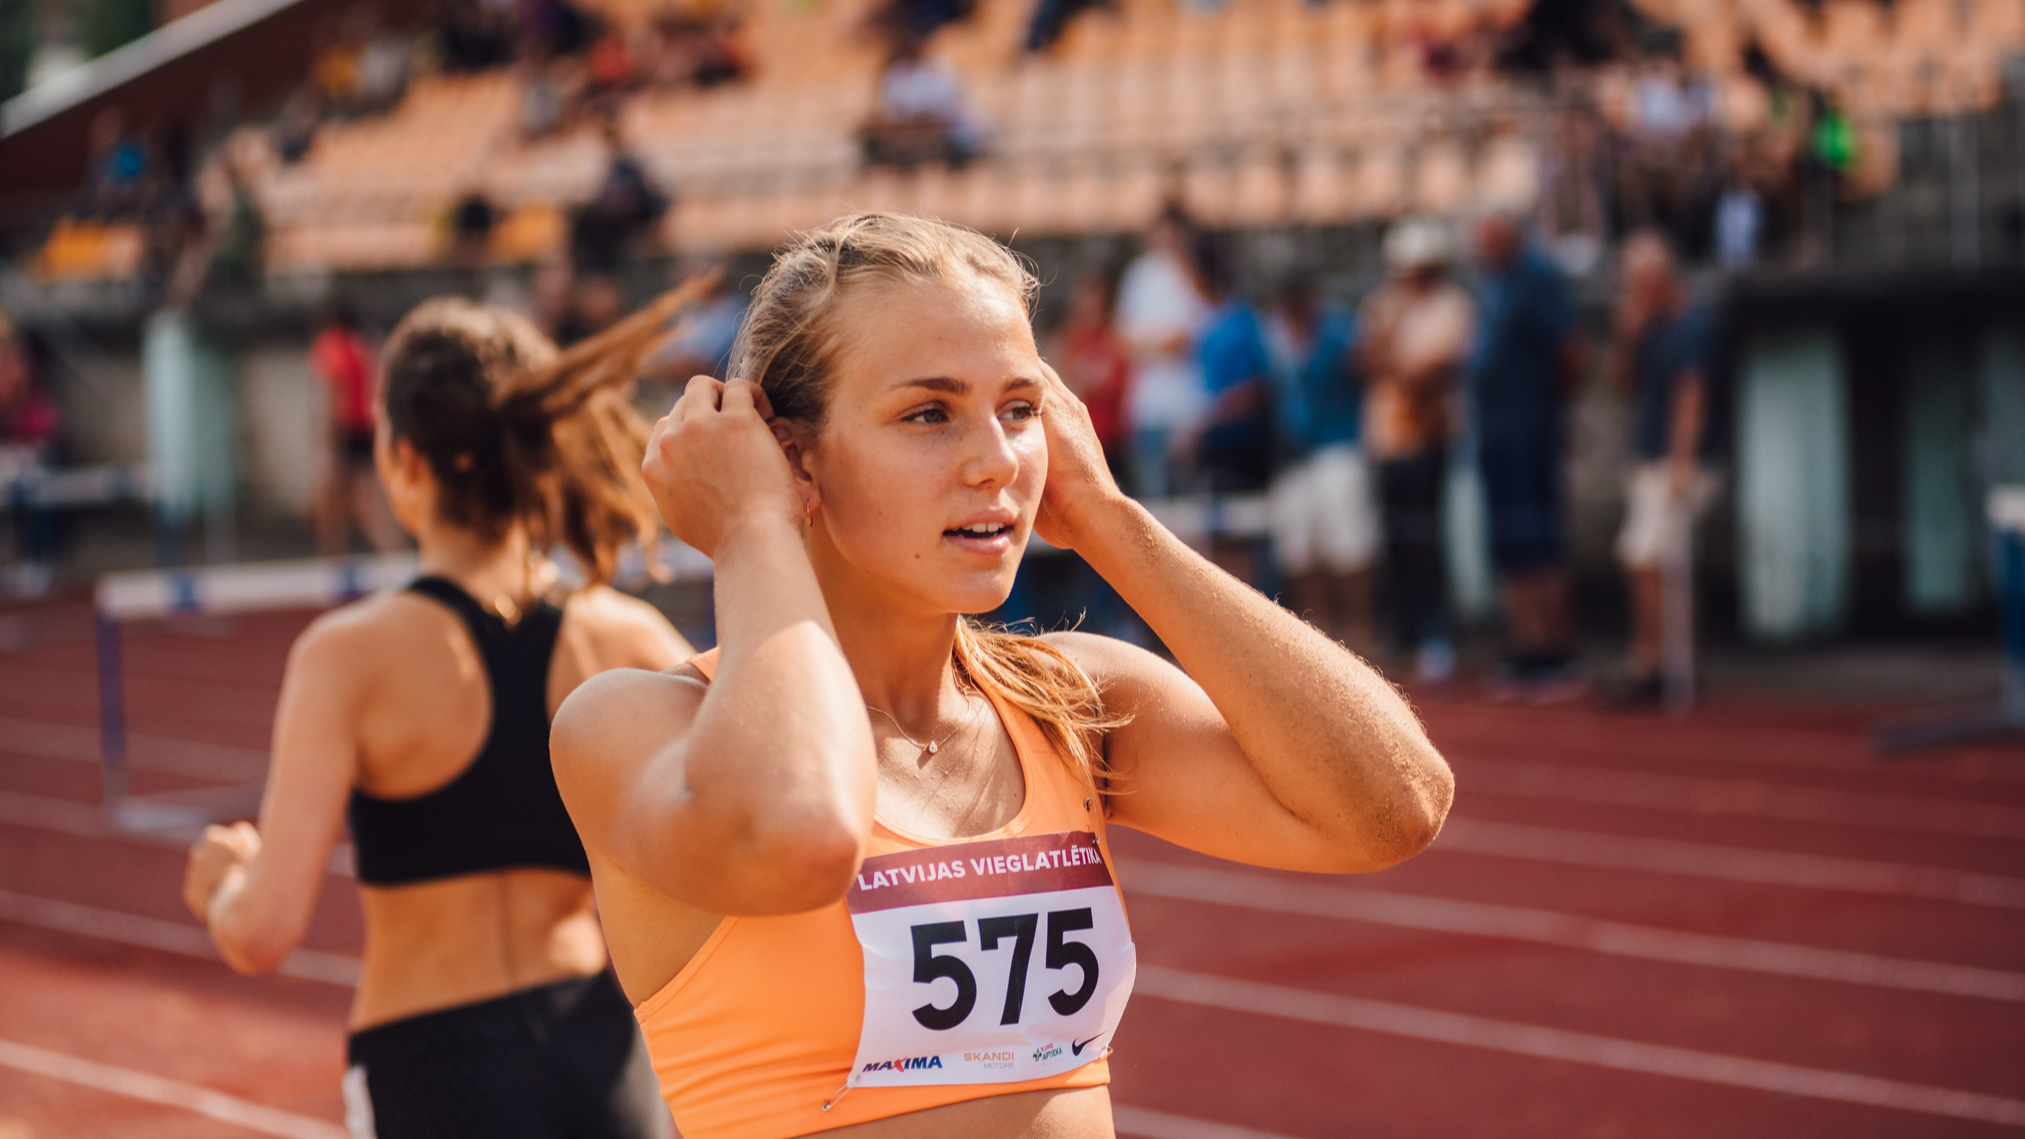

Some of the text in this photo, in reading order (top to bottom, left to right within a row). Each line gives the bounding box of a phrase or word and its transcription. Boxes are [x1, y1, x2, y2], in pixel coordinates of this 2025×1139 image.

[857, 844, 1102, 891] LATVIJAS VIEGLATLĒTIKA
[910, 907, 1100, 1031] 575
[862, 1055, 943, 1073] MAXIMA
[963, 1052, 1015, 1062] SKANDI
[983, 1062, 1015, 1070] MOTORS
